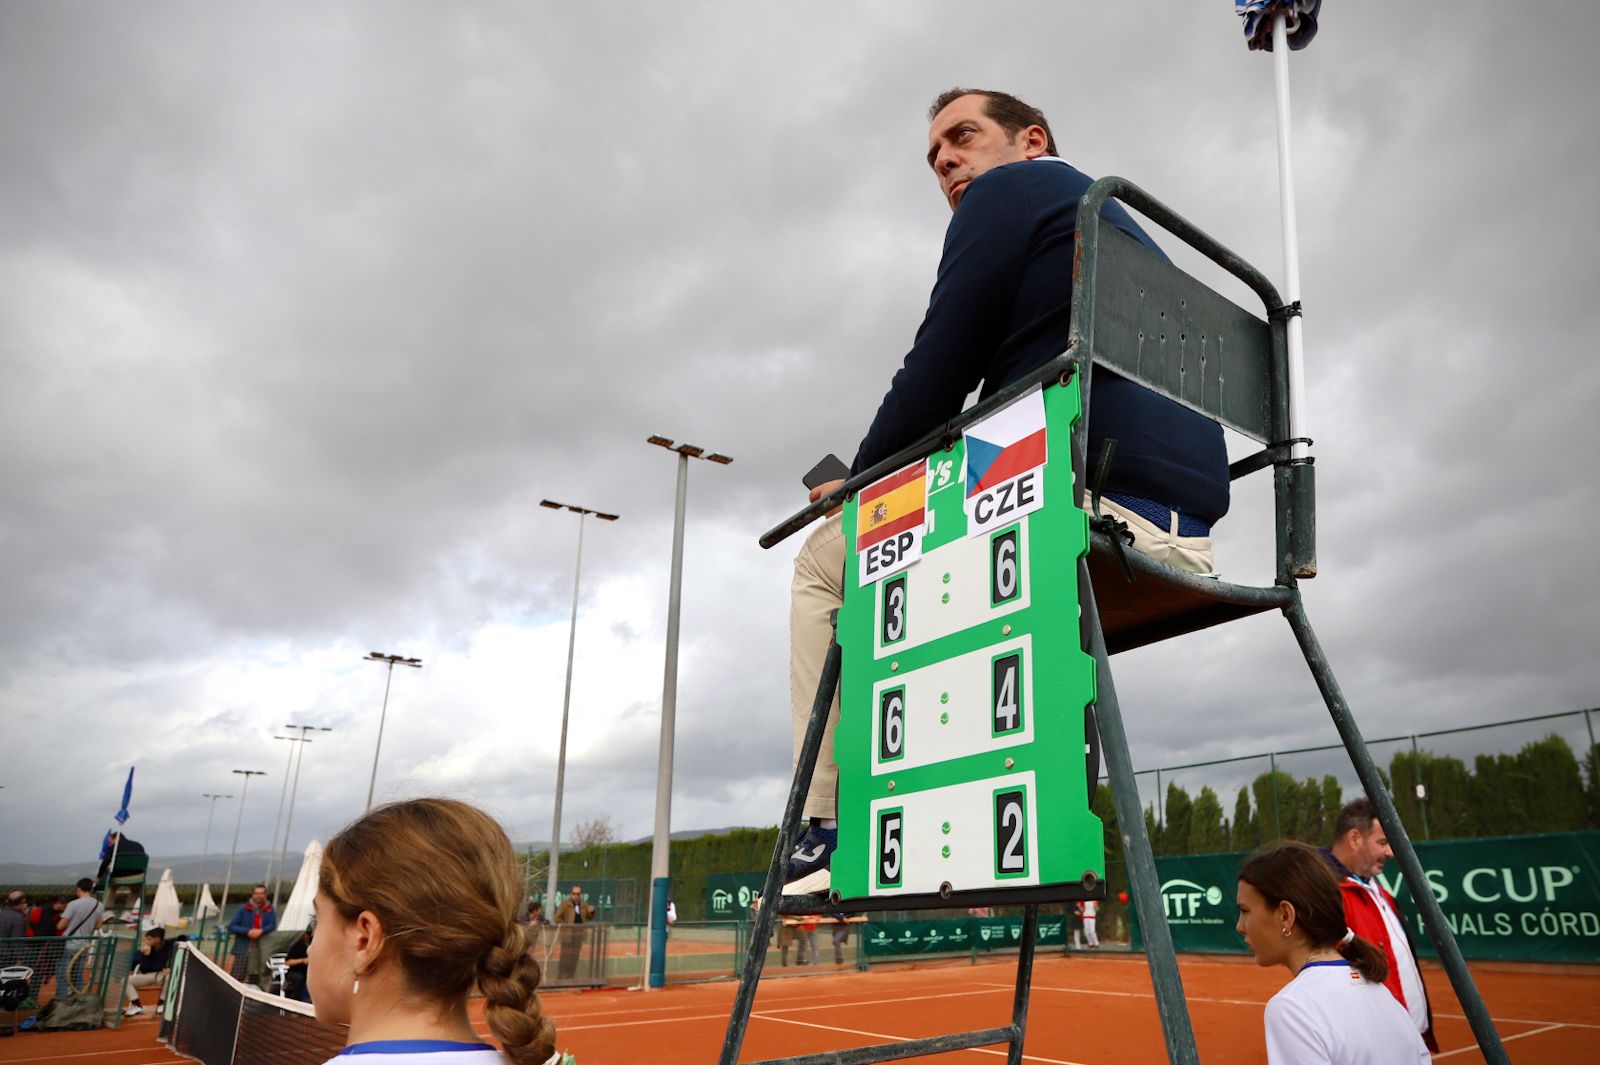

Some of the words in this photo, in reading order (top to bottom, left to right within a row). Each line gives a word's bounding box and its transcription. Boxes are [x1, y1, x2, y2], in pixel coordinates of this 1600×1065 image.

[975, 472, 1035, 525] CZE
[866, 531, 914, 576] ESP
[887, 586, 905, 641] 3
[996, 539, 1017, 598] 6
[886, 697, 903, 753] 6
[996, 666, 1017, 729] 4
[883, 818, 901, 879] 5
[1002, 802, 1024, 869] 2
[1162, 893, 1202, 917] ITF
[1462, 866, 1574, 903] CUP
[1417, 912, 1513, 936] FNALS
